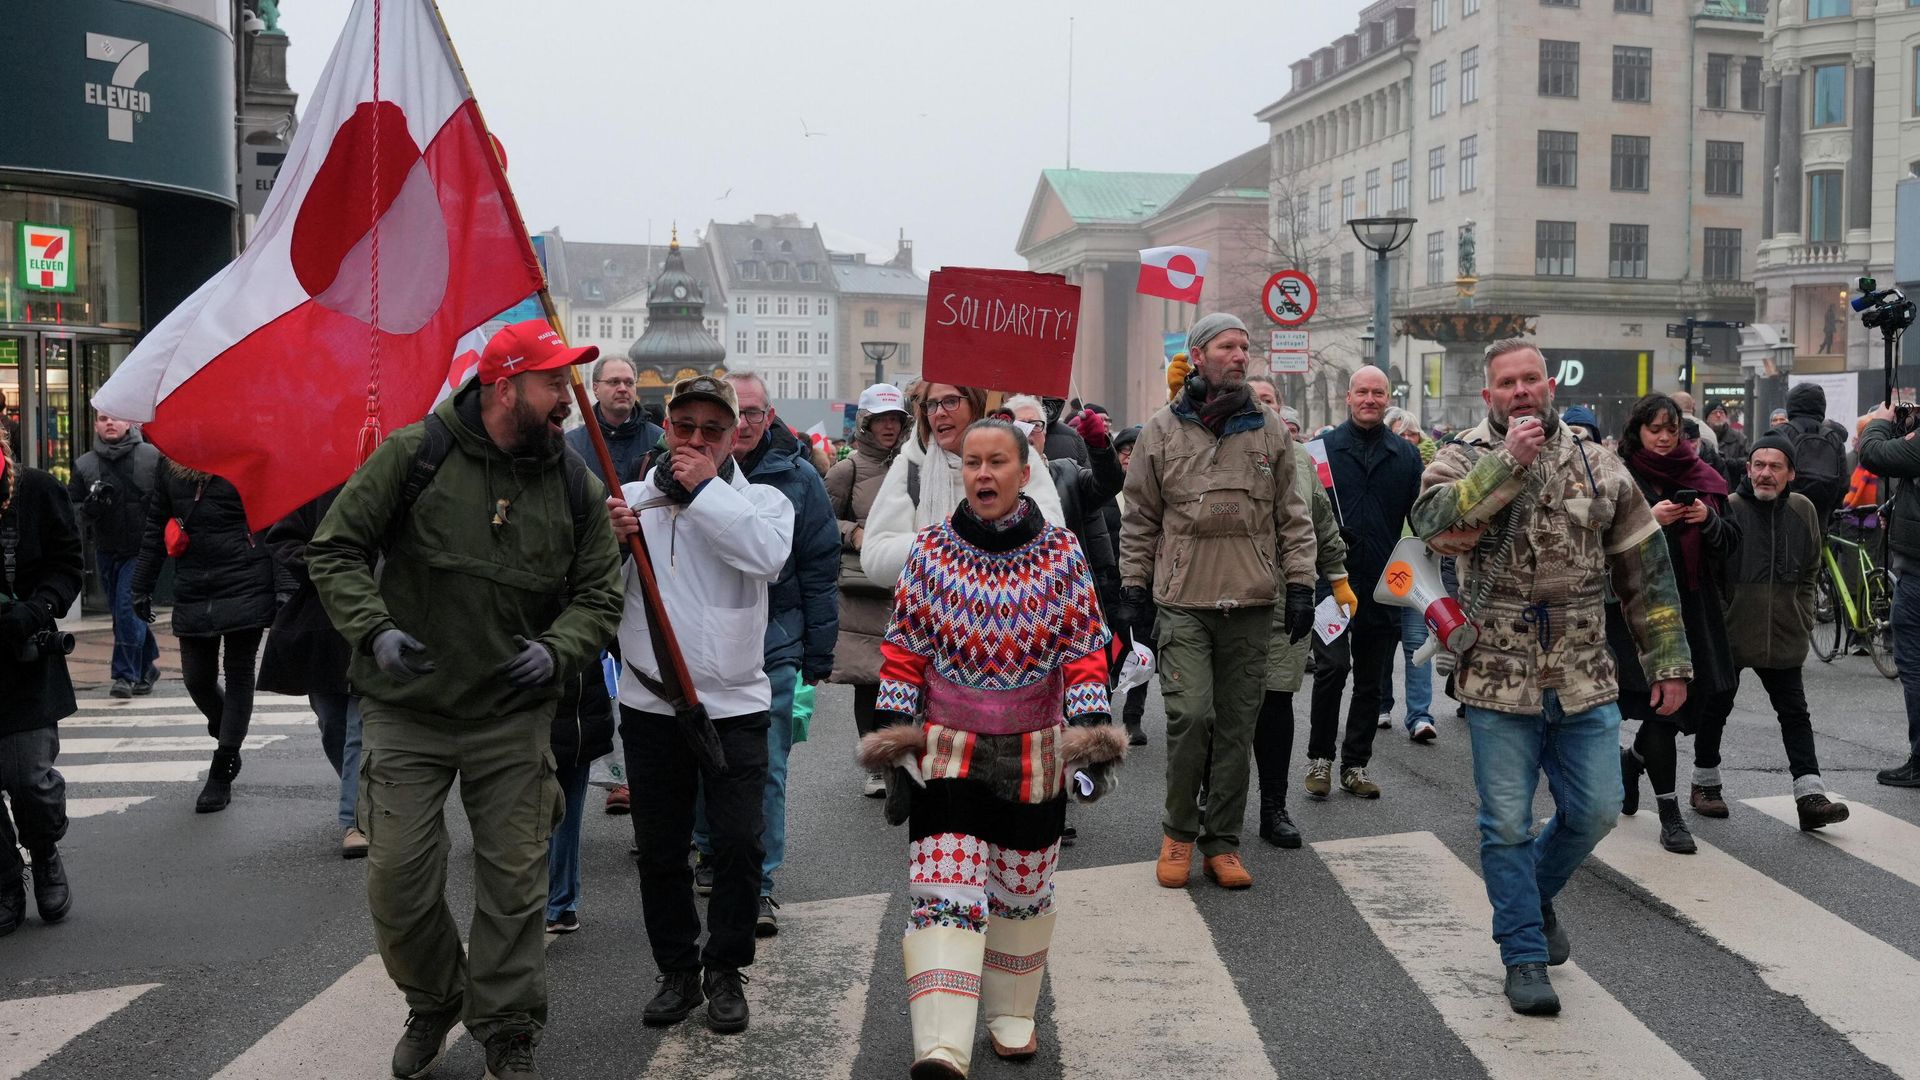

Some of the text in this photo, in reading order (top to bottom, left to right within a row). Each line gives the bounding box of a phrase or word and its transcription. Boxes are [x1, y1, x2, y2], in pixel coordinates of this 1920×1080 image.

[86, 32, 149, 142] 7
[31, 234, 63, 287] 7
[937, 293, 1072, 340] SOLIDARITY!
